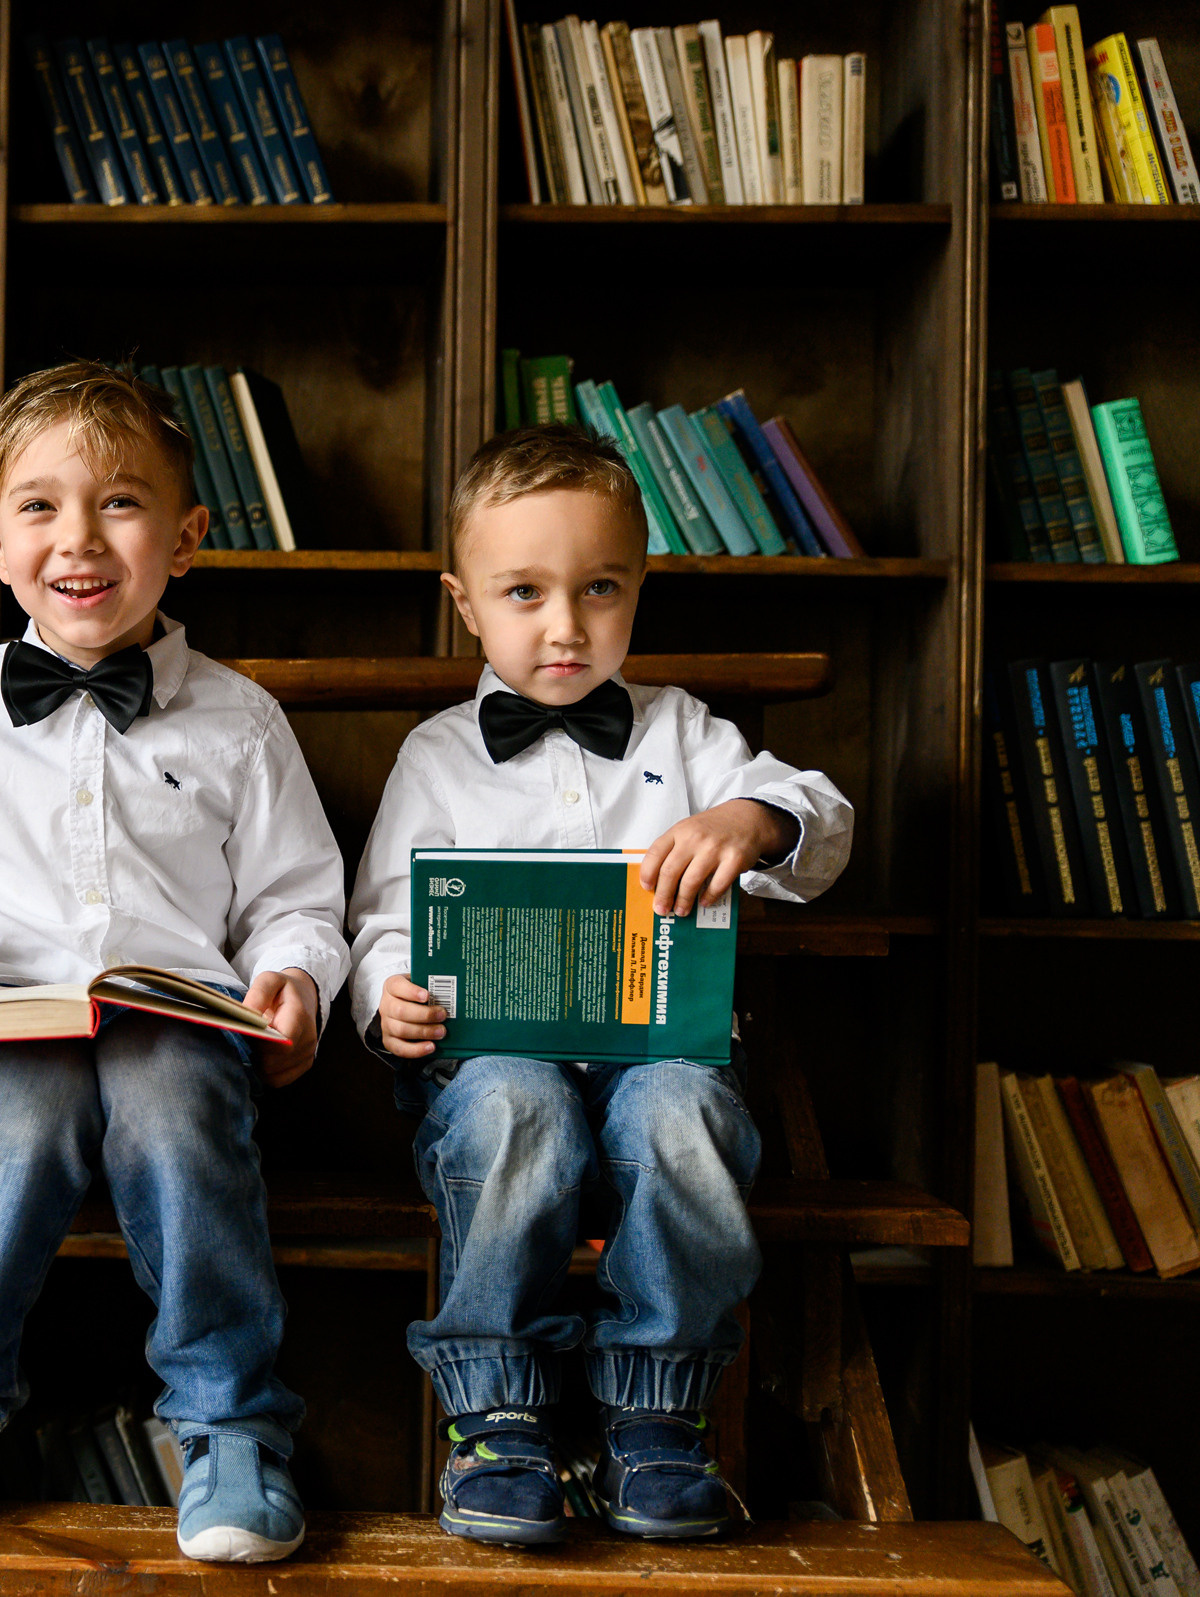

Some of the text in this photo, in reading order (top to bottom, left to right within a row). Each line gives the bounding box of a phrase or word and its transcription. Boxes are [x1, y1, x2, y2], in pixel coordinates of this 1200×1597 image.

[628, 968, 636, 1002] Леффлер
[655, 911, 675, 1025] Нефтехимия
[485, 1411, 538, 1423] sports
